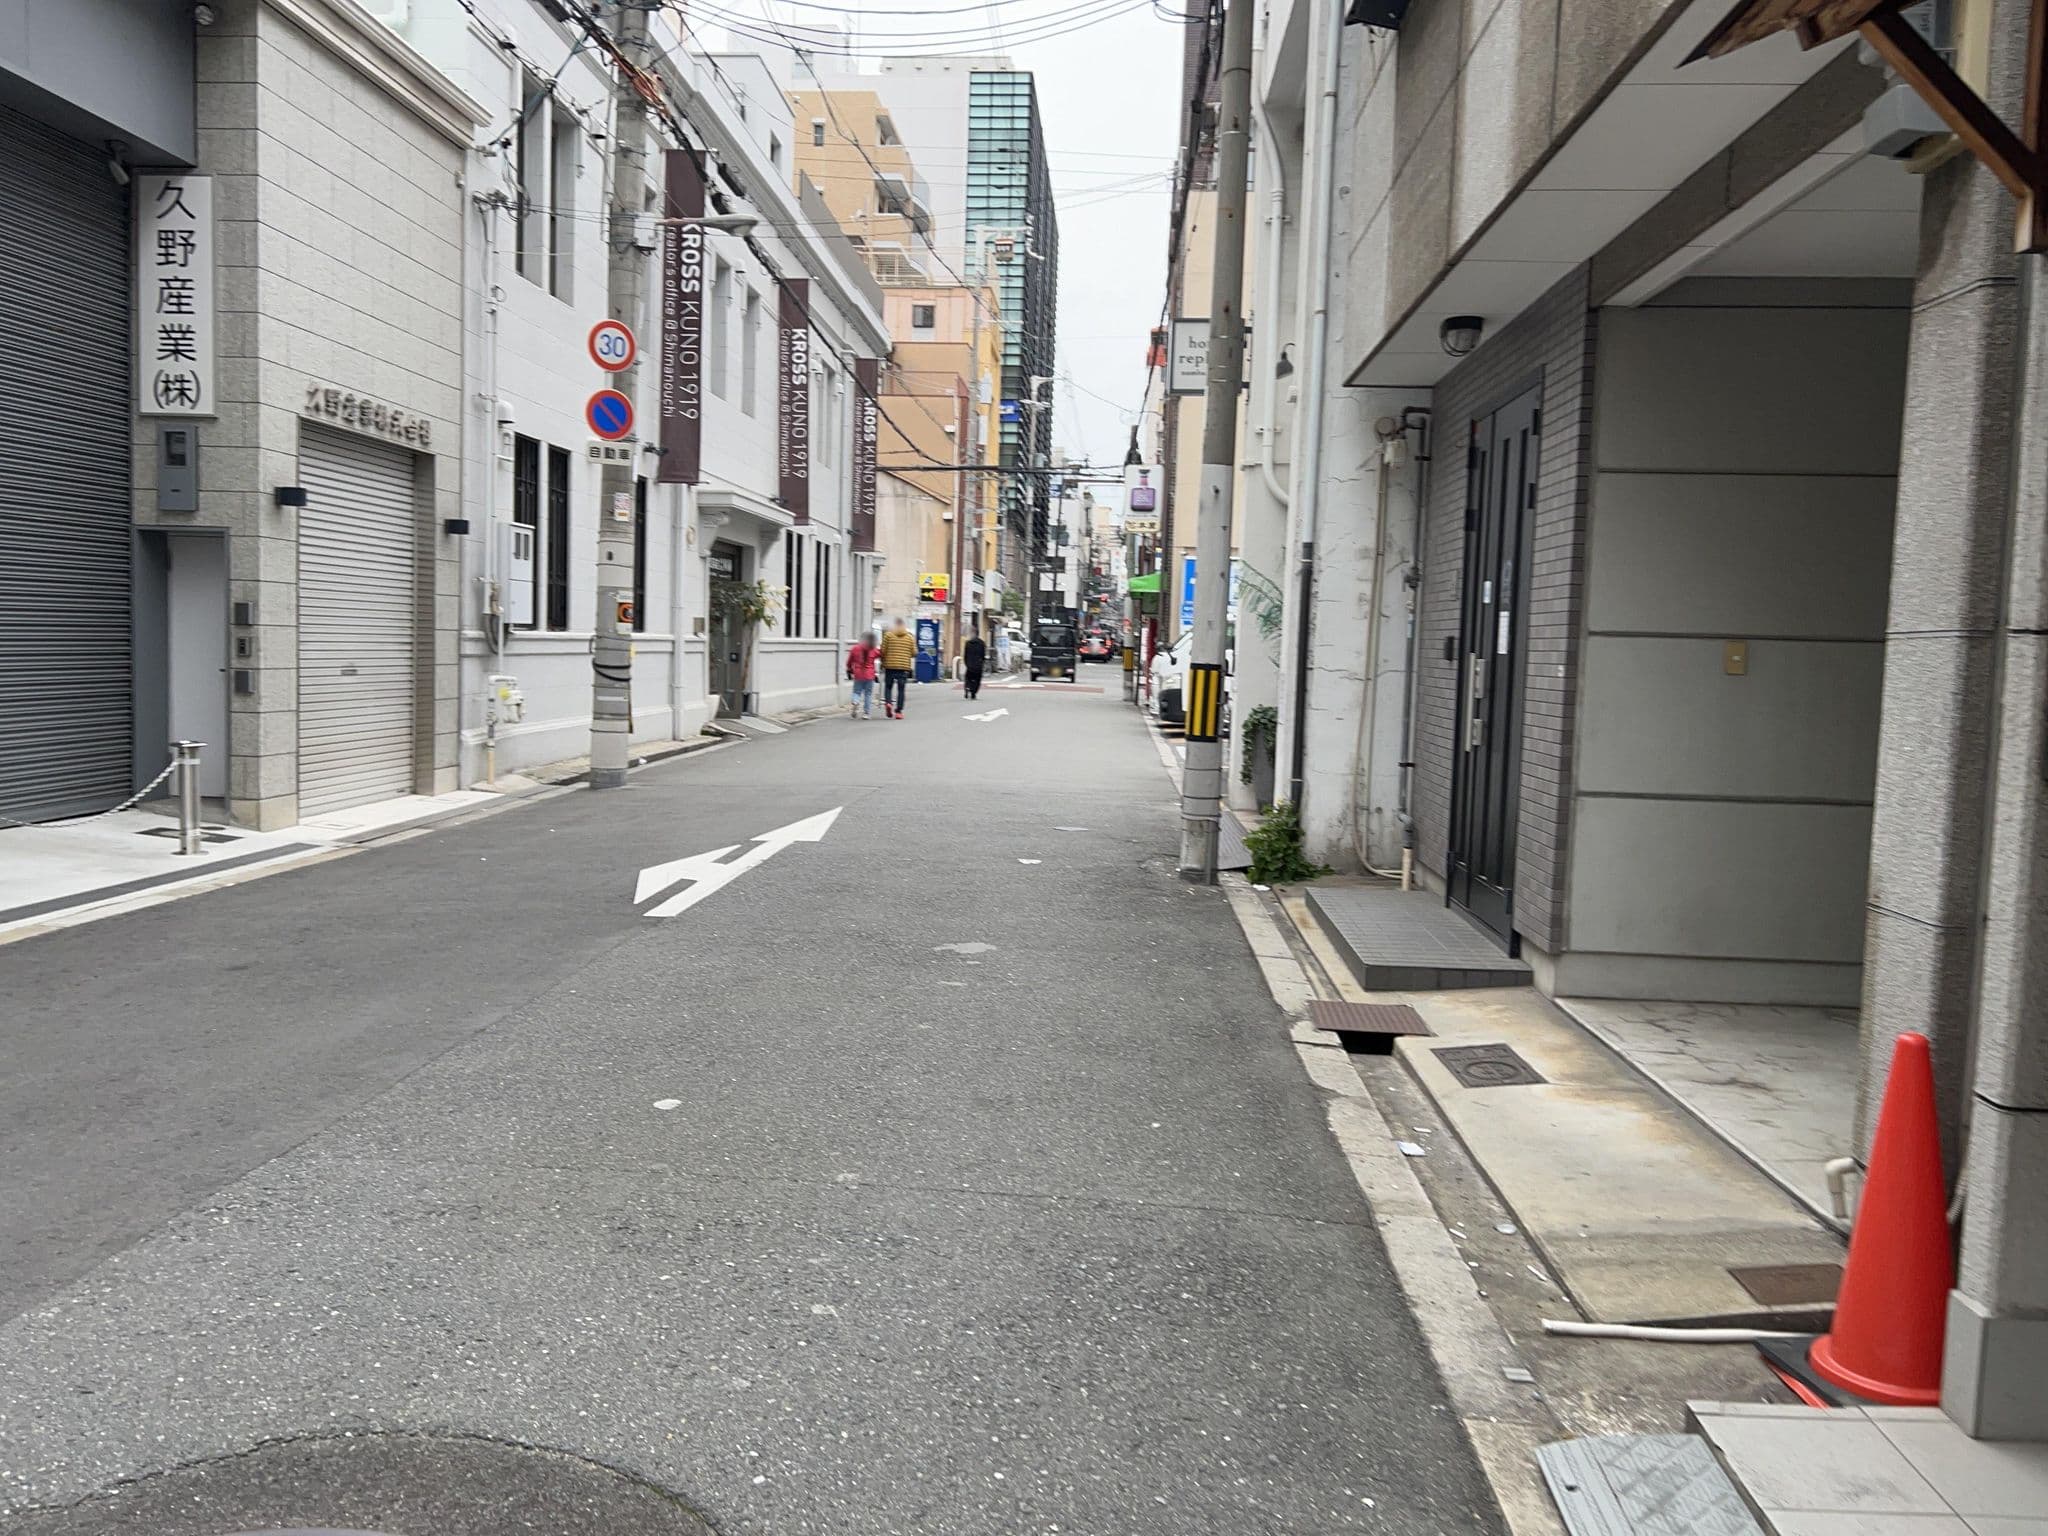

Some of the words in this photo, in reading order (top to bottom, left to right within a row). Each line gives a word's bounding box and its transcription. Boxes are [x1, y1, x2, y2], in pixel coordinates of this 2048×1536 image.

[665, 225, 679, 276] reator's
[664, 279, 679, 315] office
[664, 319, 679, 330] @
[679, 300, 700, 365] KUNO
[598, 333, 626, 358] 30
[791, 328, 808, 385] KROSS
[663, 333, 679, 417] Shimanouchi
[678, 371, 699, 419] 1919
[791, 390, 808, 438] KUNO
[589, 446, 630, 460] 自動車
[791, 443, 808, 478] 1919
[863, 445, 876, 484] KUNO
[862, 487, 875, 515] 1919
